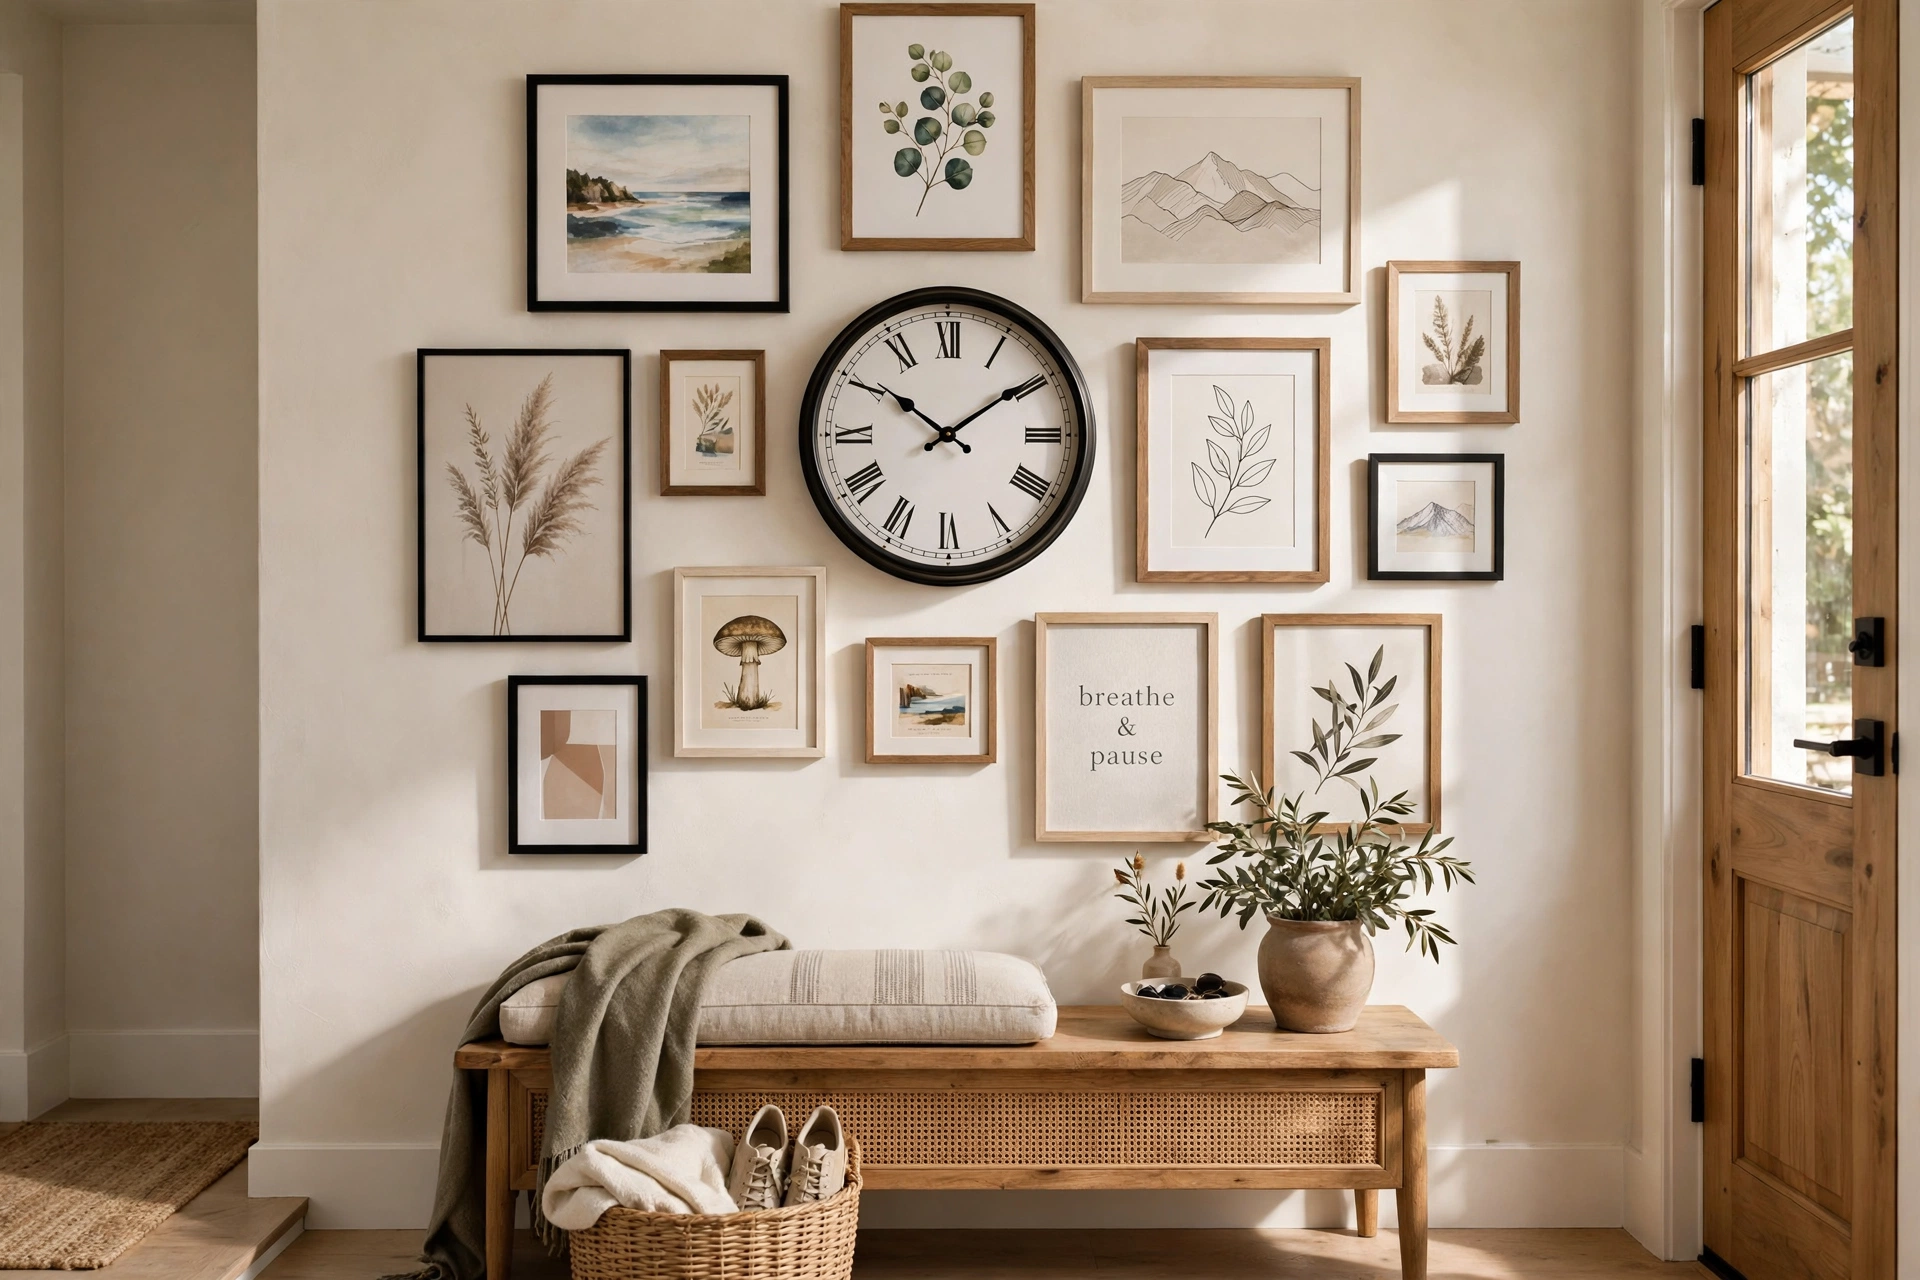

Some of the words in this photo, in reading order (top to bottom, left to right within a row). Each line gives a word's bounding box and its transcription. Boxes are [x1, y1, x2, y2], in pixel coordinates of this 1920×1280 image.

[884, 332, 918, 374] XI
[935, 322, 961, 359] XII
[984, 335, 1007, 369] I
[848, 373, 886, 404] X
[836, 424, 873, 445] IX
[1025, 426, 1061, 444] III
[844, 459, 886, 505] VIII
[883, 495, 915, 539] VII
[938, 512, 960, 549] VI
[987, 502, 1011, 538] V
[1079, 685, 1175, 706] breathe
[1118, 716, 1137, 736] &
[1090, 750, 1163, 771] pause
